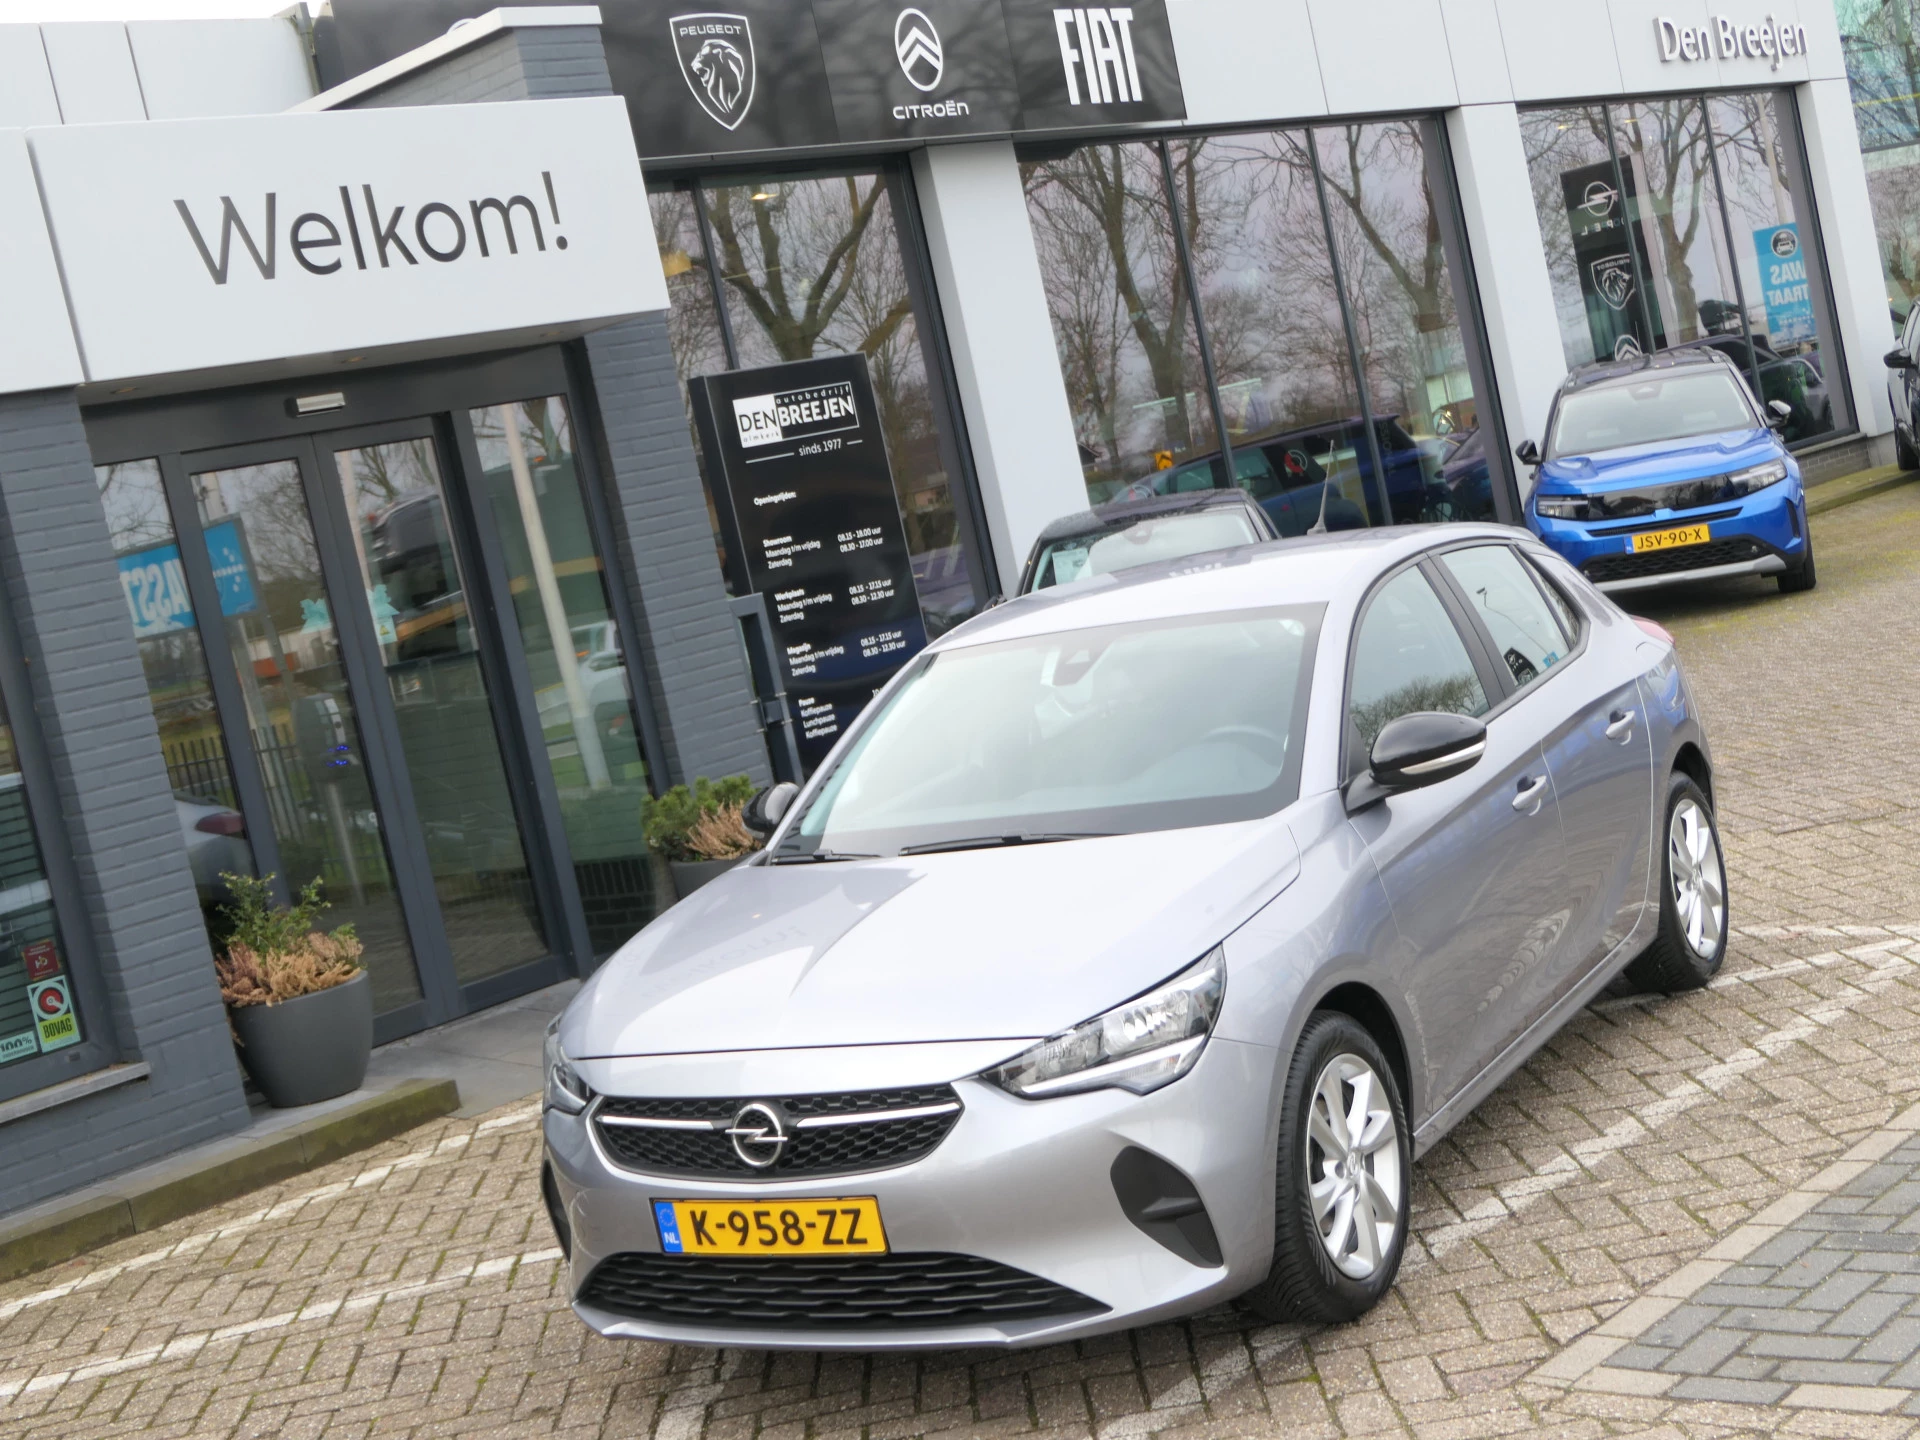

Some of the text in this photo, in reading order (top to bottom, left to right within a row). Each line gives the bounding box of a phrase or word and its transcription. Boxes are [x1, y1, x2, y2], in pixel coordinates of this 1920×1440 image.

[680, 24, 741, 37] PEUGEOT
[1653, 12, 1809, 72] Den Breejen
[1053, 7, 1143, 106] FIAT
[172, 170, 568, 286] Welkom!
[776, 384, 850, 405] autobedrijf
[738, 395, 855, 433] DEN BREEJEN
[798, 438, 842, 456] sinds 1977
[872, 527, 881, 535] uur
[1638, 527, 1703, 550] JSV-90-X
[873, 537, 883, 546] uur
[882, 579, 892, 587] uur
[885, 589, 895, 598] uur
[892, 630, 902, 639] uur
[896, 640, 906, 649] uur
[43, 1017, 73, 1039] BOVAG
[664, 1207, 868, 1247] NL K-958-ZZ
